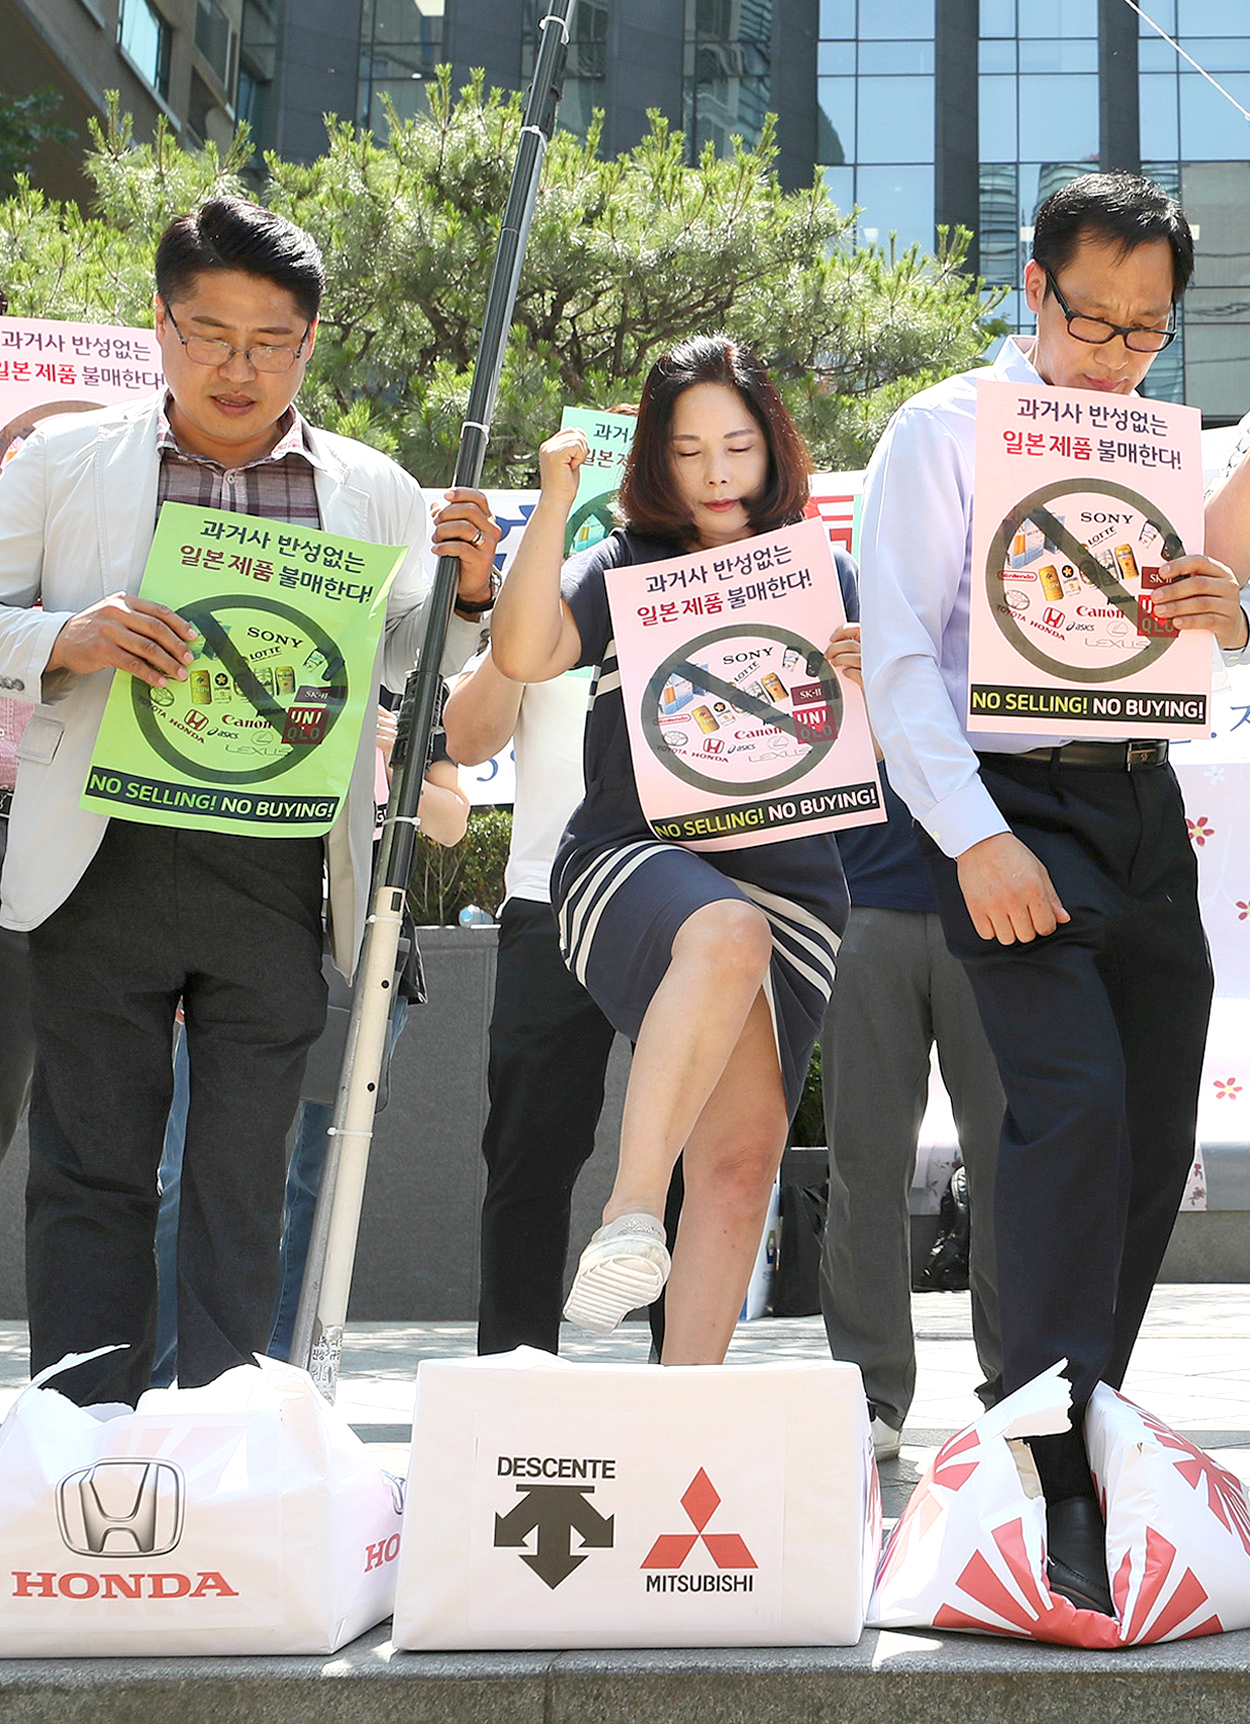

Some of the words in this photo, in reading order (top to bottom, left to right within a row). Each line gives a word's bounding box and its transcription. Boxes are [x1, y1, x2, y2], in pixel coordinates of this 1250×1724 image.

[1, 331, 65, 352] 과거사
[72, 336, 151, 362] 반성없는
[35, 364, 77, 385] 제품
[1017, 398, 1082, 424] 과거사
[1089, 406, 1168, 437] 반성없는
[594, 423, 634, 443] 과거
[1002, 430, 1046, 456] 일본
[1049, 436, 1092, 460] 제품
[1097, 439, 1181, 470] 불매한다!
[1080, 512, 1133, 524] SONY
[1088, 526, 1116, 545] LOTTE
[200, 520, 270, 549] 과거사
[278, 535, 365, 573] 반성없는
[180, 544, 224, 571] 일본
[228, 554, 274, 582] 제품
[279, 566, 374, 604] 불매한다!
[645, 565, 708, 593] 과거사
[713, 545, 793, 581] 반성없는
[637, 603, 679, 627] 일본
[682, 592, 723, 615] 제품
[727, 569, 813, 608] 불매한다!
[1076, 604, 1124, 619] Canon
[247, 627, 302, 648] SONY
[1030, 620, 1065, 641] HONDA
[250, 646, 280, 660] LOTTE
[1085, 638, 1148, 649] LEXUS
[723, 647, 774, 665] SONY
[734, 662, 758, 682] LOTTE
[800, 688, 821, 699] SK-II
[972, 692, 1000, 709] NO
[1005, 693, 1088, 714] SELLING!
[1093, 698, 1121, 715] NO
[1126, 699, 1203, 719] BUYING!
[222, 714, 272, 729] Canon
[290, 711, 322, 724] UNI
[797, 710, 826, 724] UNI
[170, 719, 205, 743] HONDA
[734, 728, 781, 739] Canon
[692, 752, 729, 763] HONDA
[89, 774, 121, 794] NO
[125, 782, 217, 811] SELLING!
[221, 800, 252, 814] NO
[255, 801, 337, 818] BUYING!
[655, 822, 680, 838] NO
[684, 810, 763, 836] SELLING!
[769, 802, 796, 821] NO
[800, 788, 876, 814] BUYING!
[497, 1457, 616, 1479] DESCENTE
[11, 1571, 240, 1599] HONDA
[646, 1575, 753, 1593] MITSUBISHI
